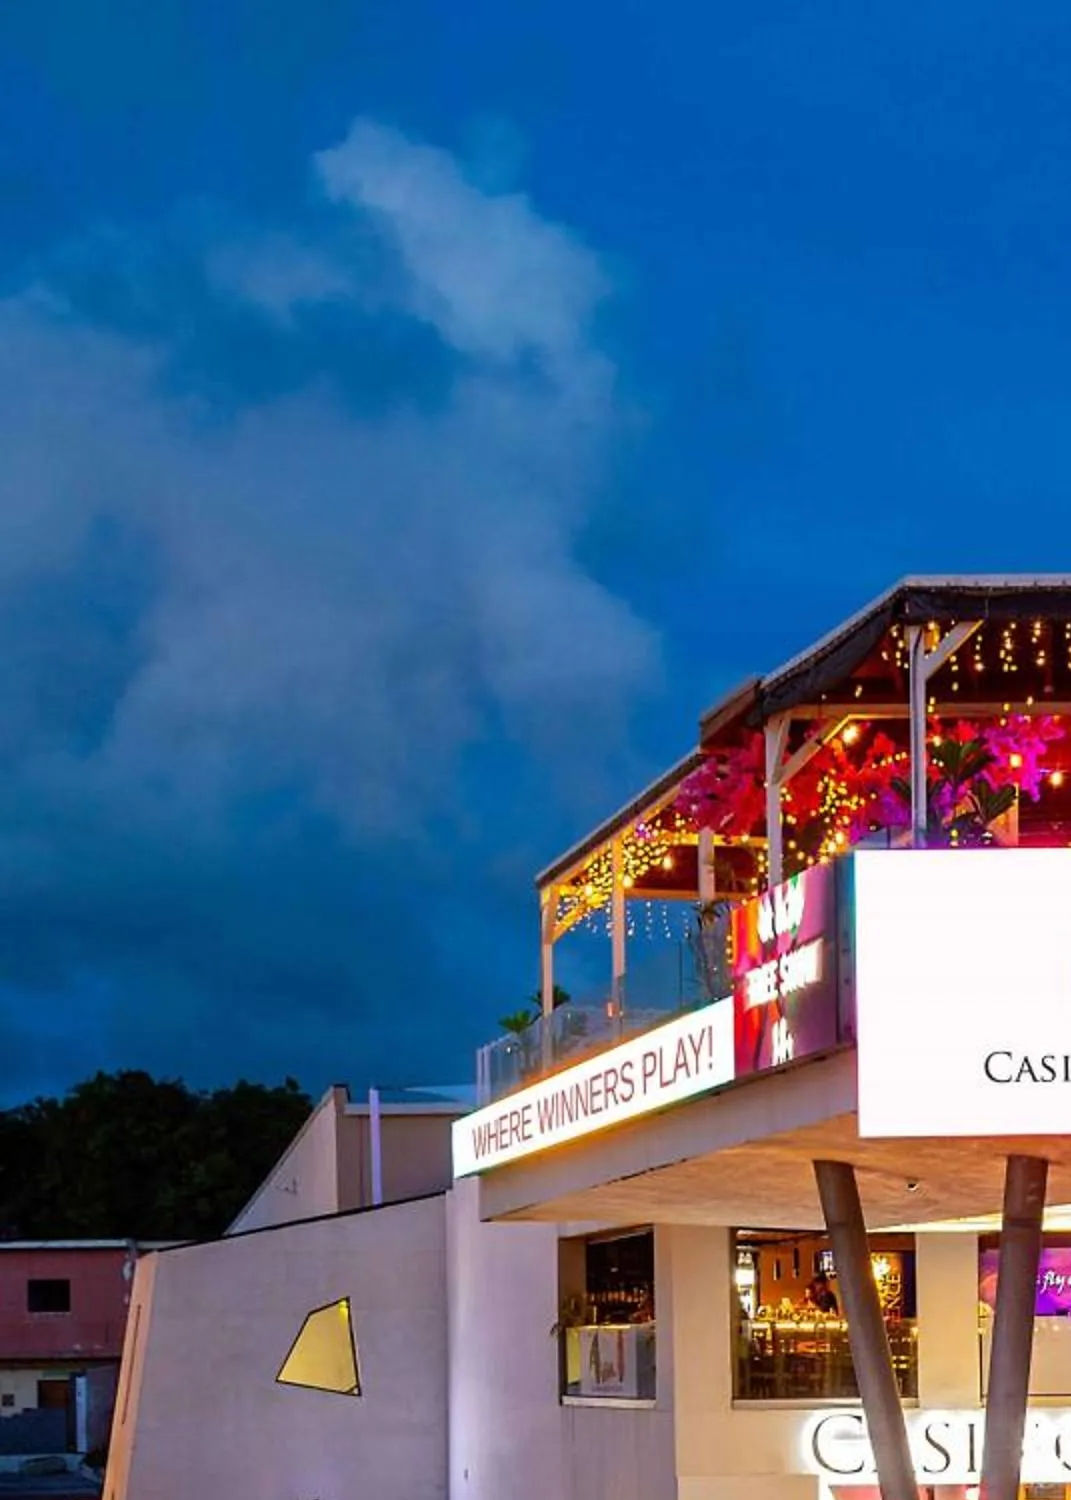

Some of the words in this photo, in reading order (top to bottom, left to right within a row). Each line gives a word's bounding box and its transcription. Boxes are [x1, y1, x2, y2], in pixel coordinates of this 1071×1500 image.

[472, 1104, 533, 1160] WHERE
[537, 1060, 635, 1134] WINNERS
[641, 1025, 714, 1095] PLAY!
